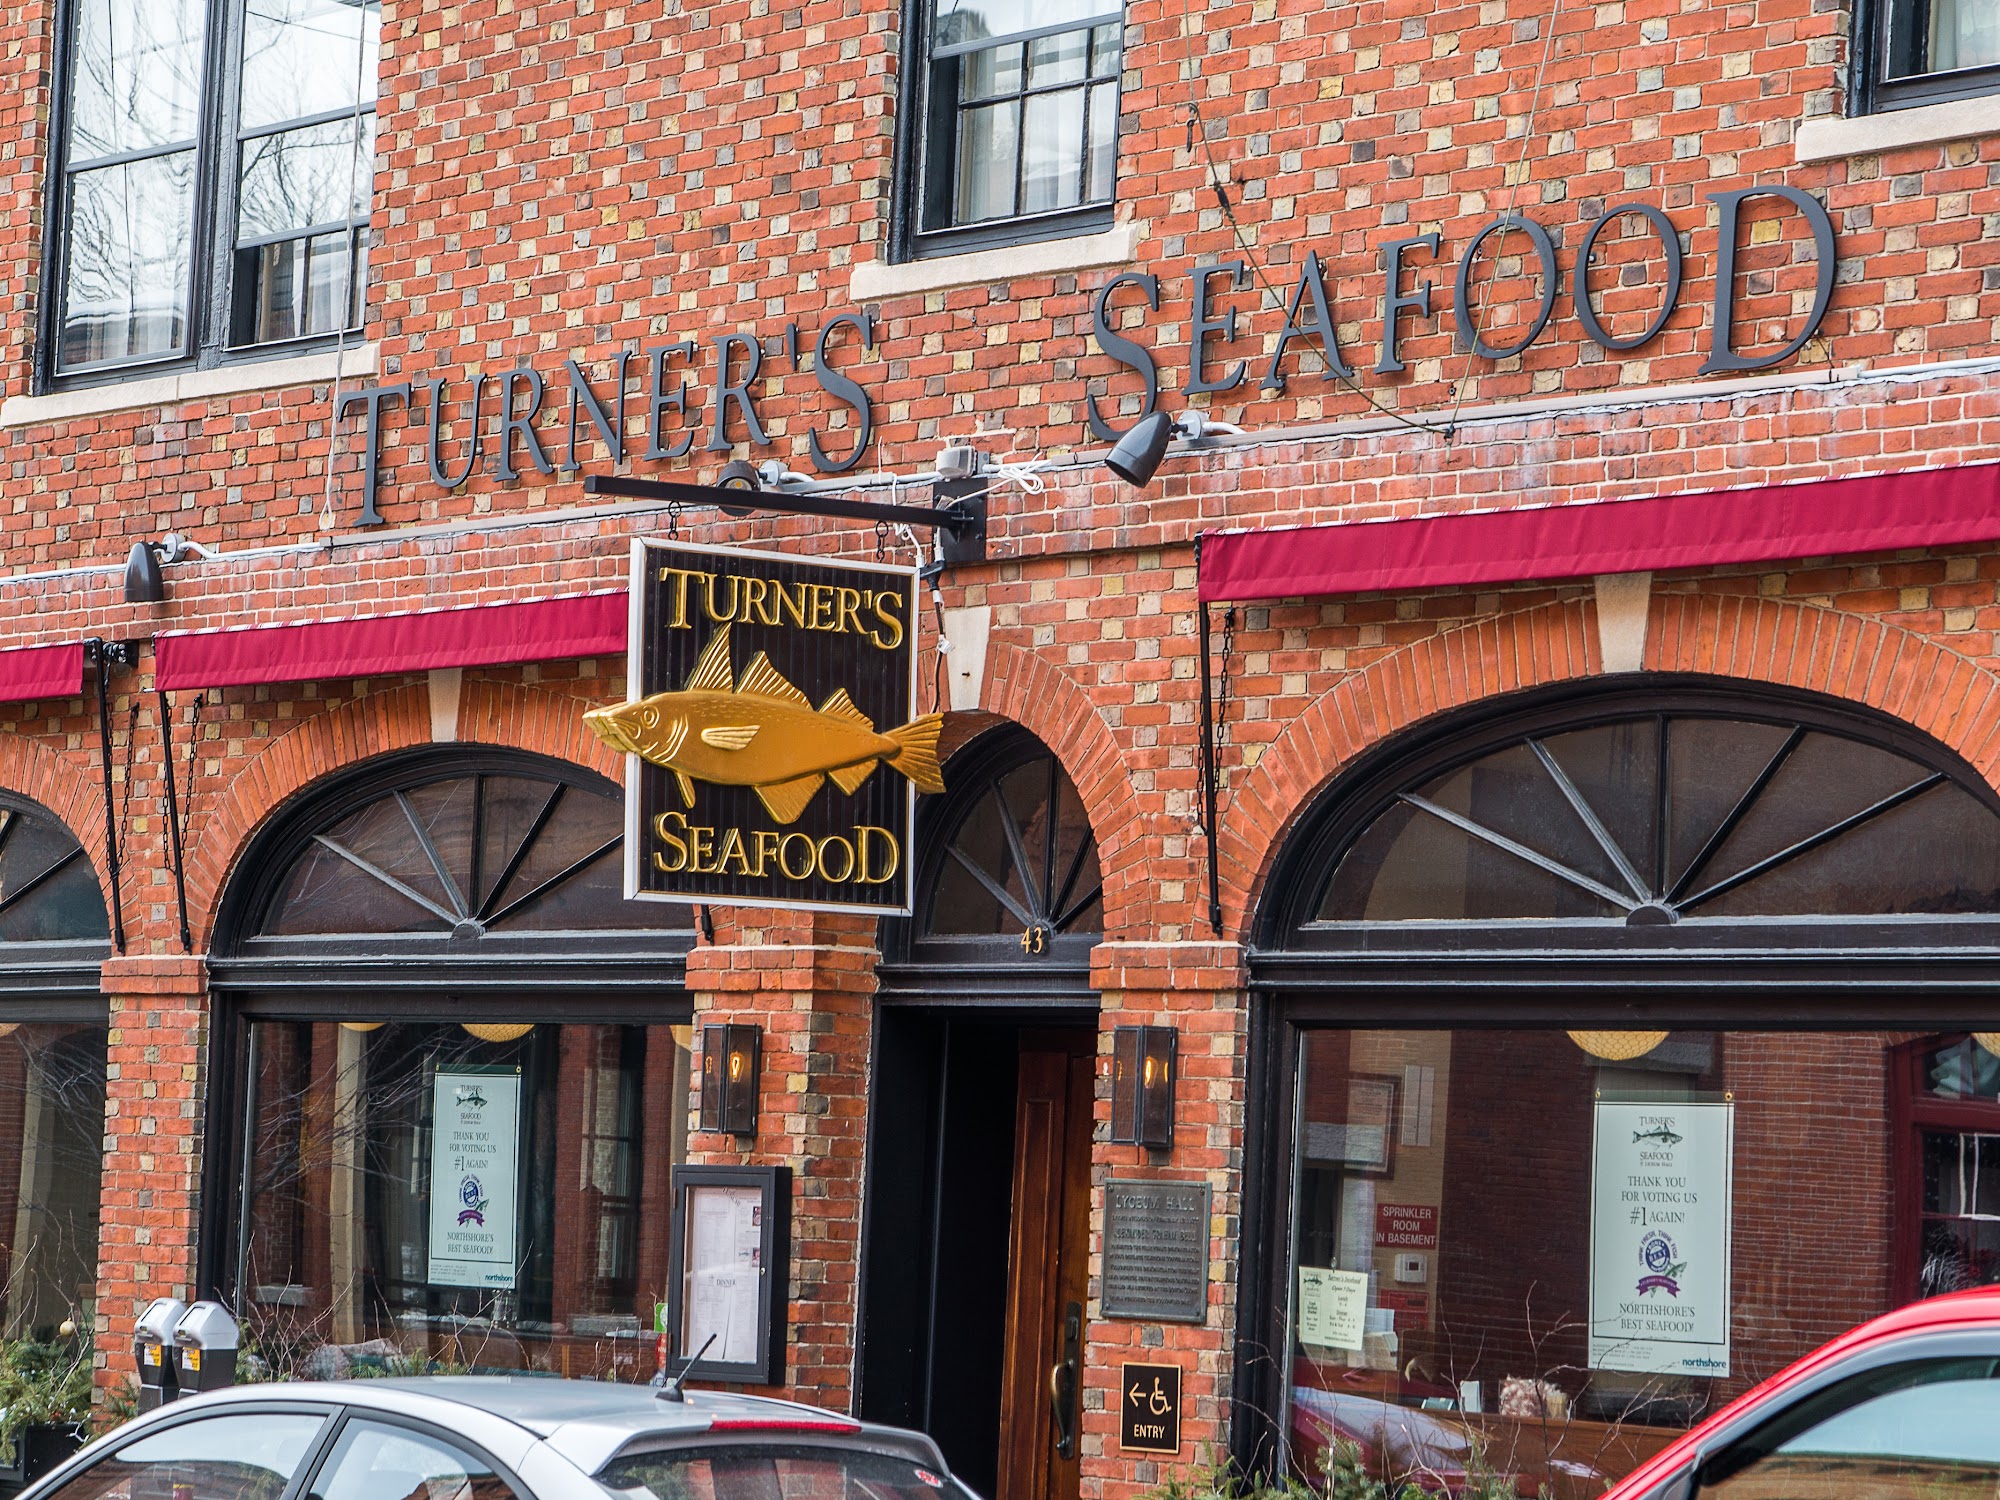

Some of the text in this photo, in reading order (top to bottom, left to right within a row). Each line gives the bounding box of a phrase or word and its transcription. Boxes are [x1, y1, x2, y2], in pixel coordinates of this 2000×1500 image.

[1087, 185, 1838, 441] SEAFOOD
[338, 313, 874, 527] TURNER'S
[659, 567, 903, 651] TURNER'S
[653, 810, 900, 885] SEAFOOD
[1021, 926, 1043, 954] 43
[1639, 1116, 1676, 1127] TURNER'S
[453, 1131, 489, 1141] THANK YOU
[449, 1143, 497, 1154] FOR VOTING US
[1640, 1151, 1674, 1161] SEAFOOD
[454, 1155, 465, 1171] #1
[1628, 1175, 1687, 1188] THANK YOU
[1115, 1194, 1195, 1211] LYCEUM HALL
[1621, 1190, 1698, 1204] FOR VOTING US
[1382, 1206, 1432, 1219] SPRINKLER
[1630, 1206, 1685, 1226] #1 AGAIN!
[1392, 1220, 1420, 1231] ROOM
[446, 1231, 494, 1243] NORTHSHORE'S
[1376, 1232, 1436, 1245] IN BASEMENT
[447, 1244, 461, 1253] BEST
[484, 1274, 513, 1282] northshore
[1619, 1302, 1695, 1318] NORTHSHORE'S
[1621, 1318, 1694, 1333] BEST SEAFOOD!
[1682, 1358, 1727, 1369] northshore
[1133, 1423, 1165, 1439] ENTRY
